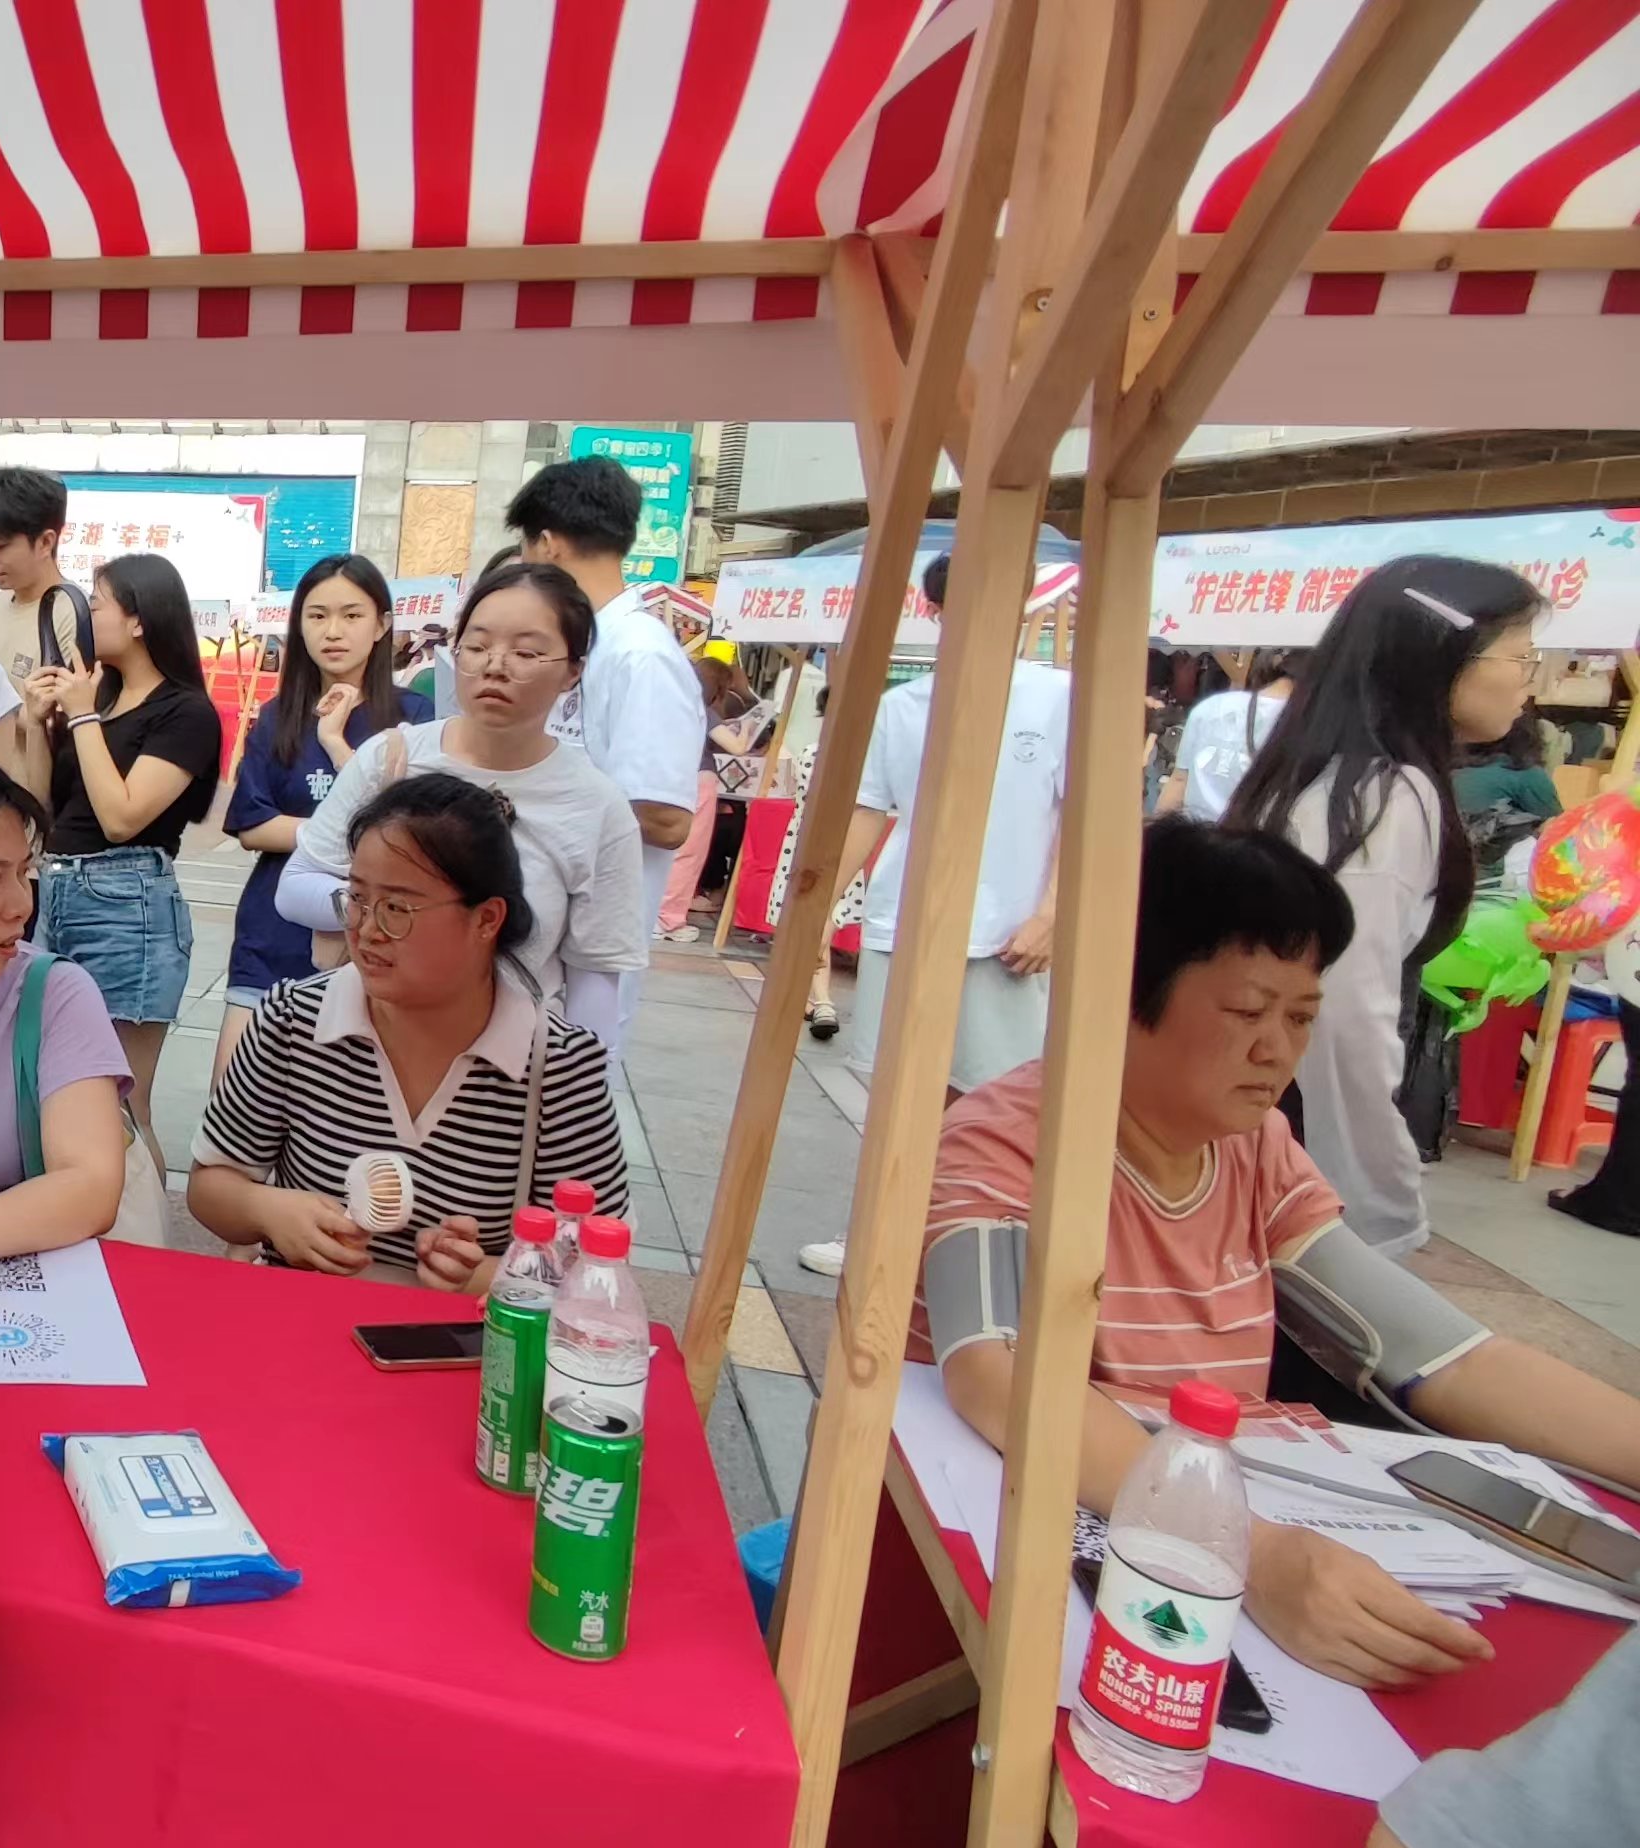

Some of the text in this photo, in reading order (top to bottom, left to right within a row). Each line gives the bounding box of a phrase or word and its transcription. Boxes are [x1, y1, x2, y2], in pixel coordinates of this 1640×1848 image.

[1296, 565, 1378, 614] 微笑
[579, 1590, 609, 1612] 汽水
[1099, 1668, 1202, 1719] NONGFU SPRING
[1103, 1645, 1208, 1705] 农夫山泉
